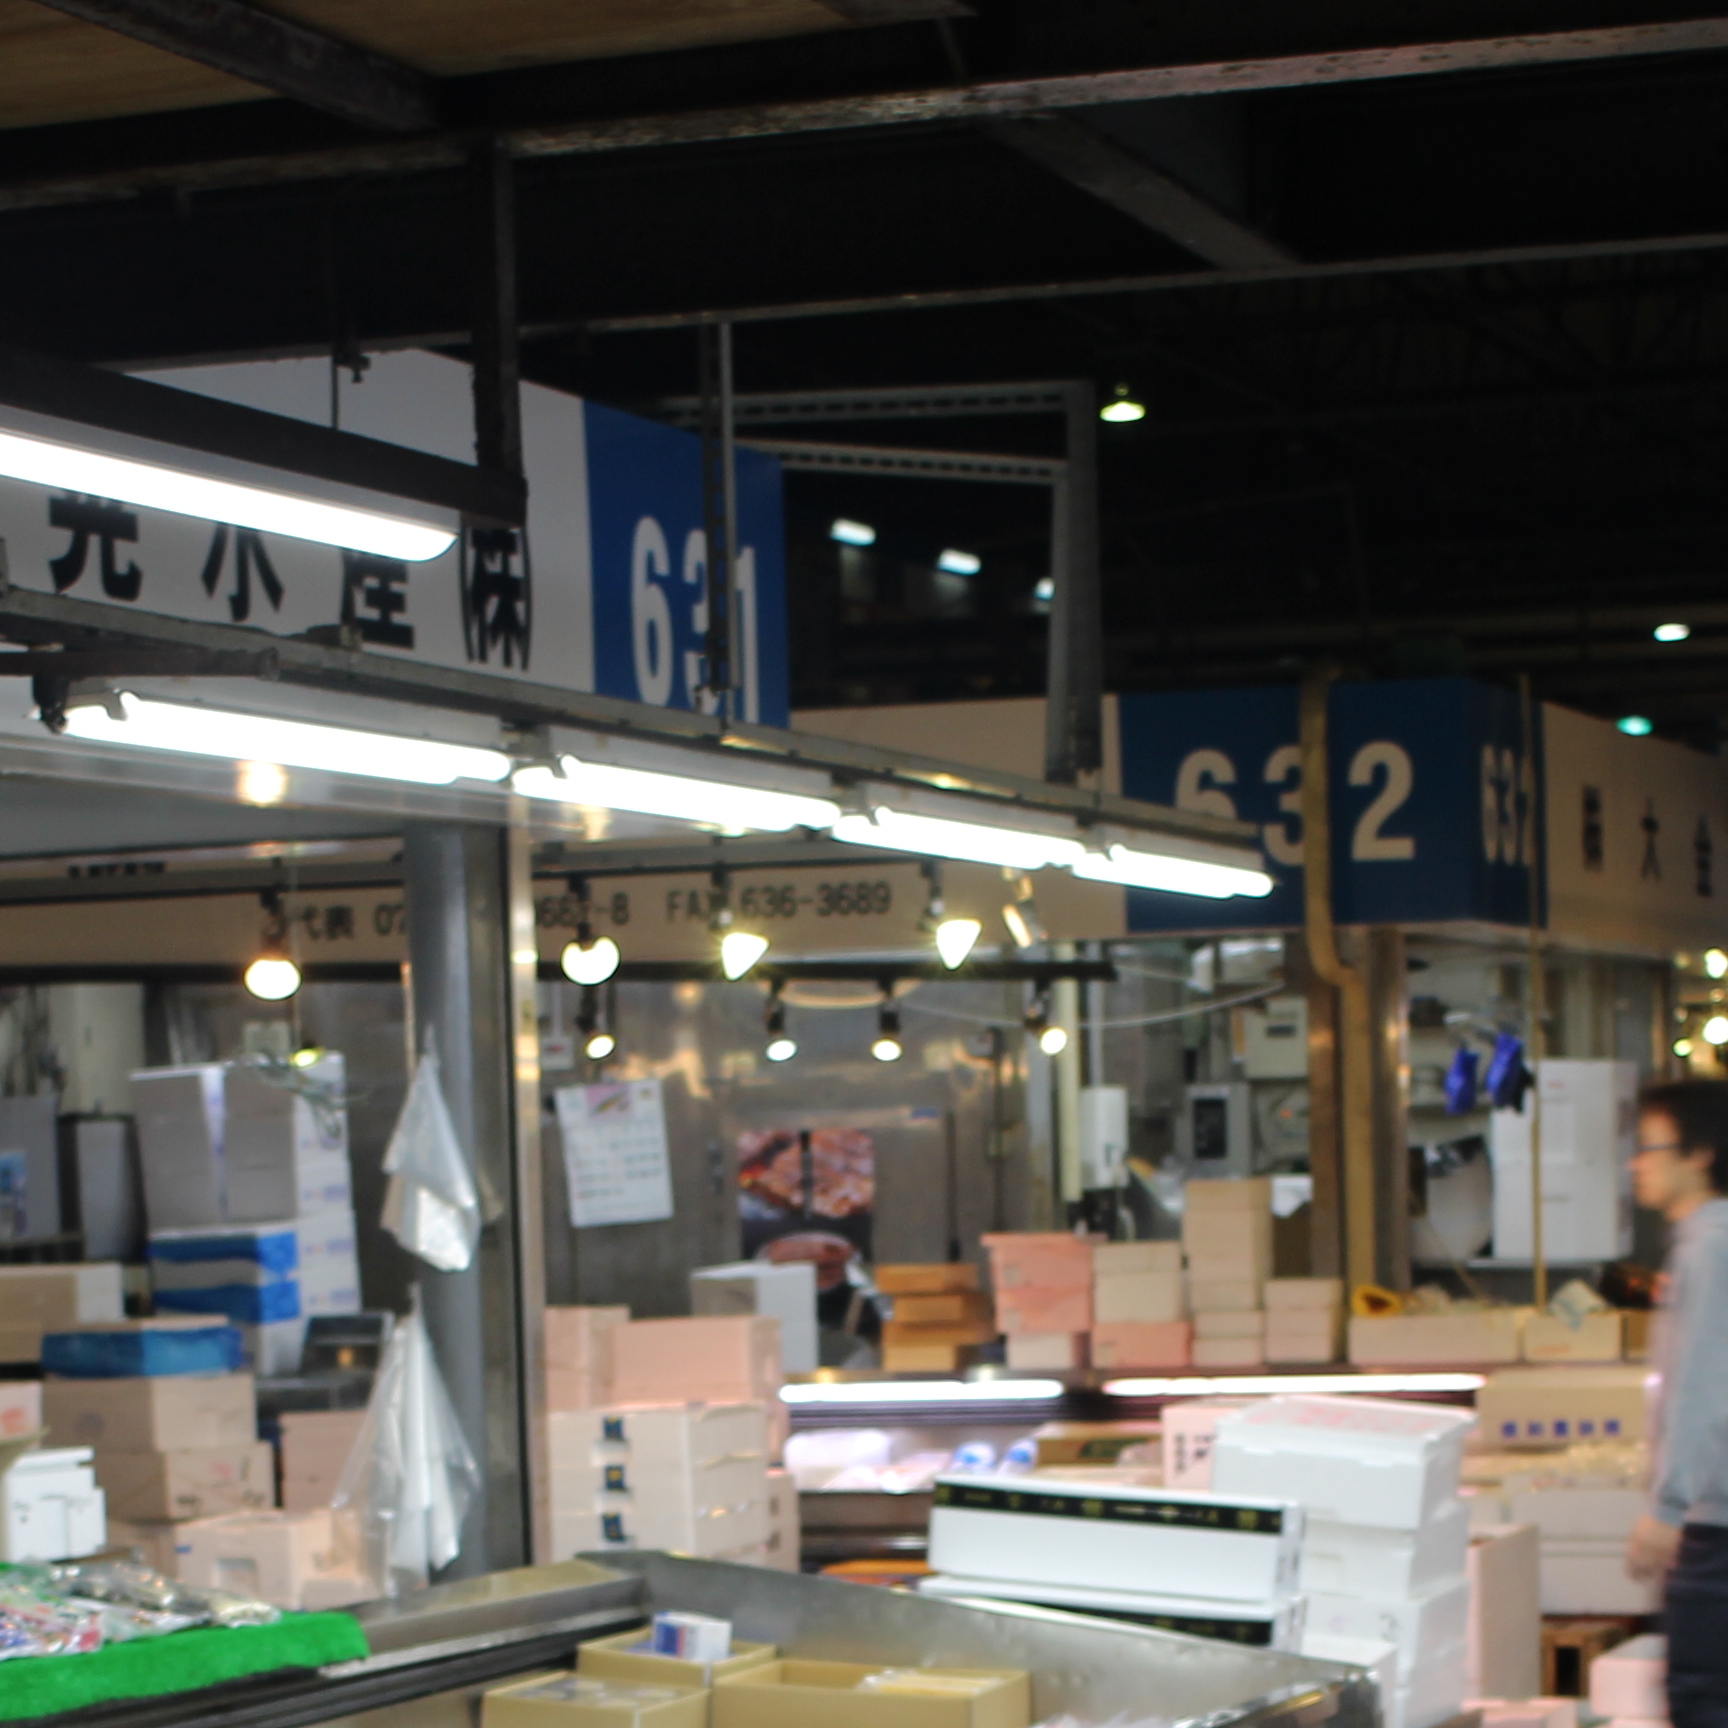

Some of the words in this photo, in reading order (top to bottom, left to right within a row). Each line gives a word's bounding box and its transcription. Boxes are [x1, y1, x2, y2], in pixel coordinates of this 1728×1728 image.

[632, 515, 759, 723] 631
[1175, 741, 1416, 866] 632
[741, 880, 892, 918] 636-3689
